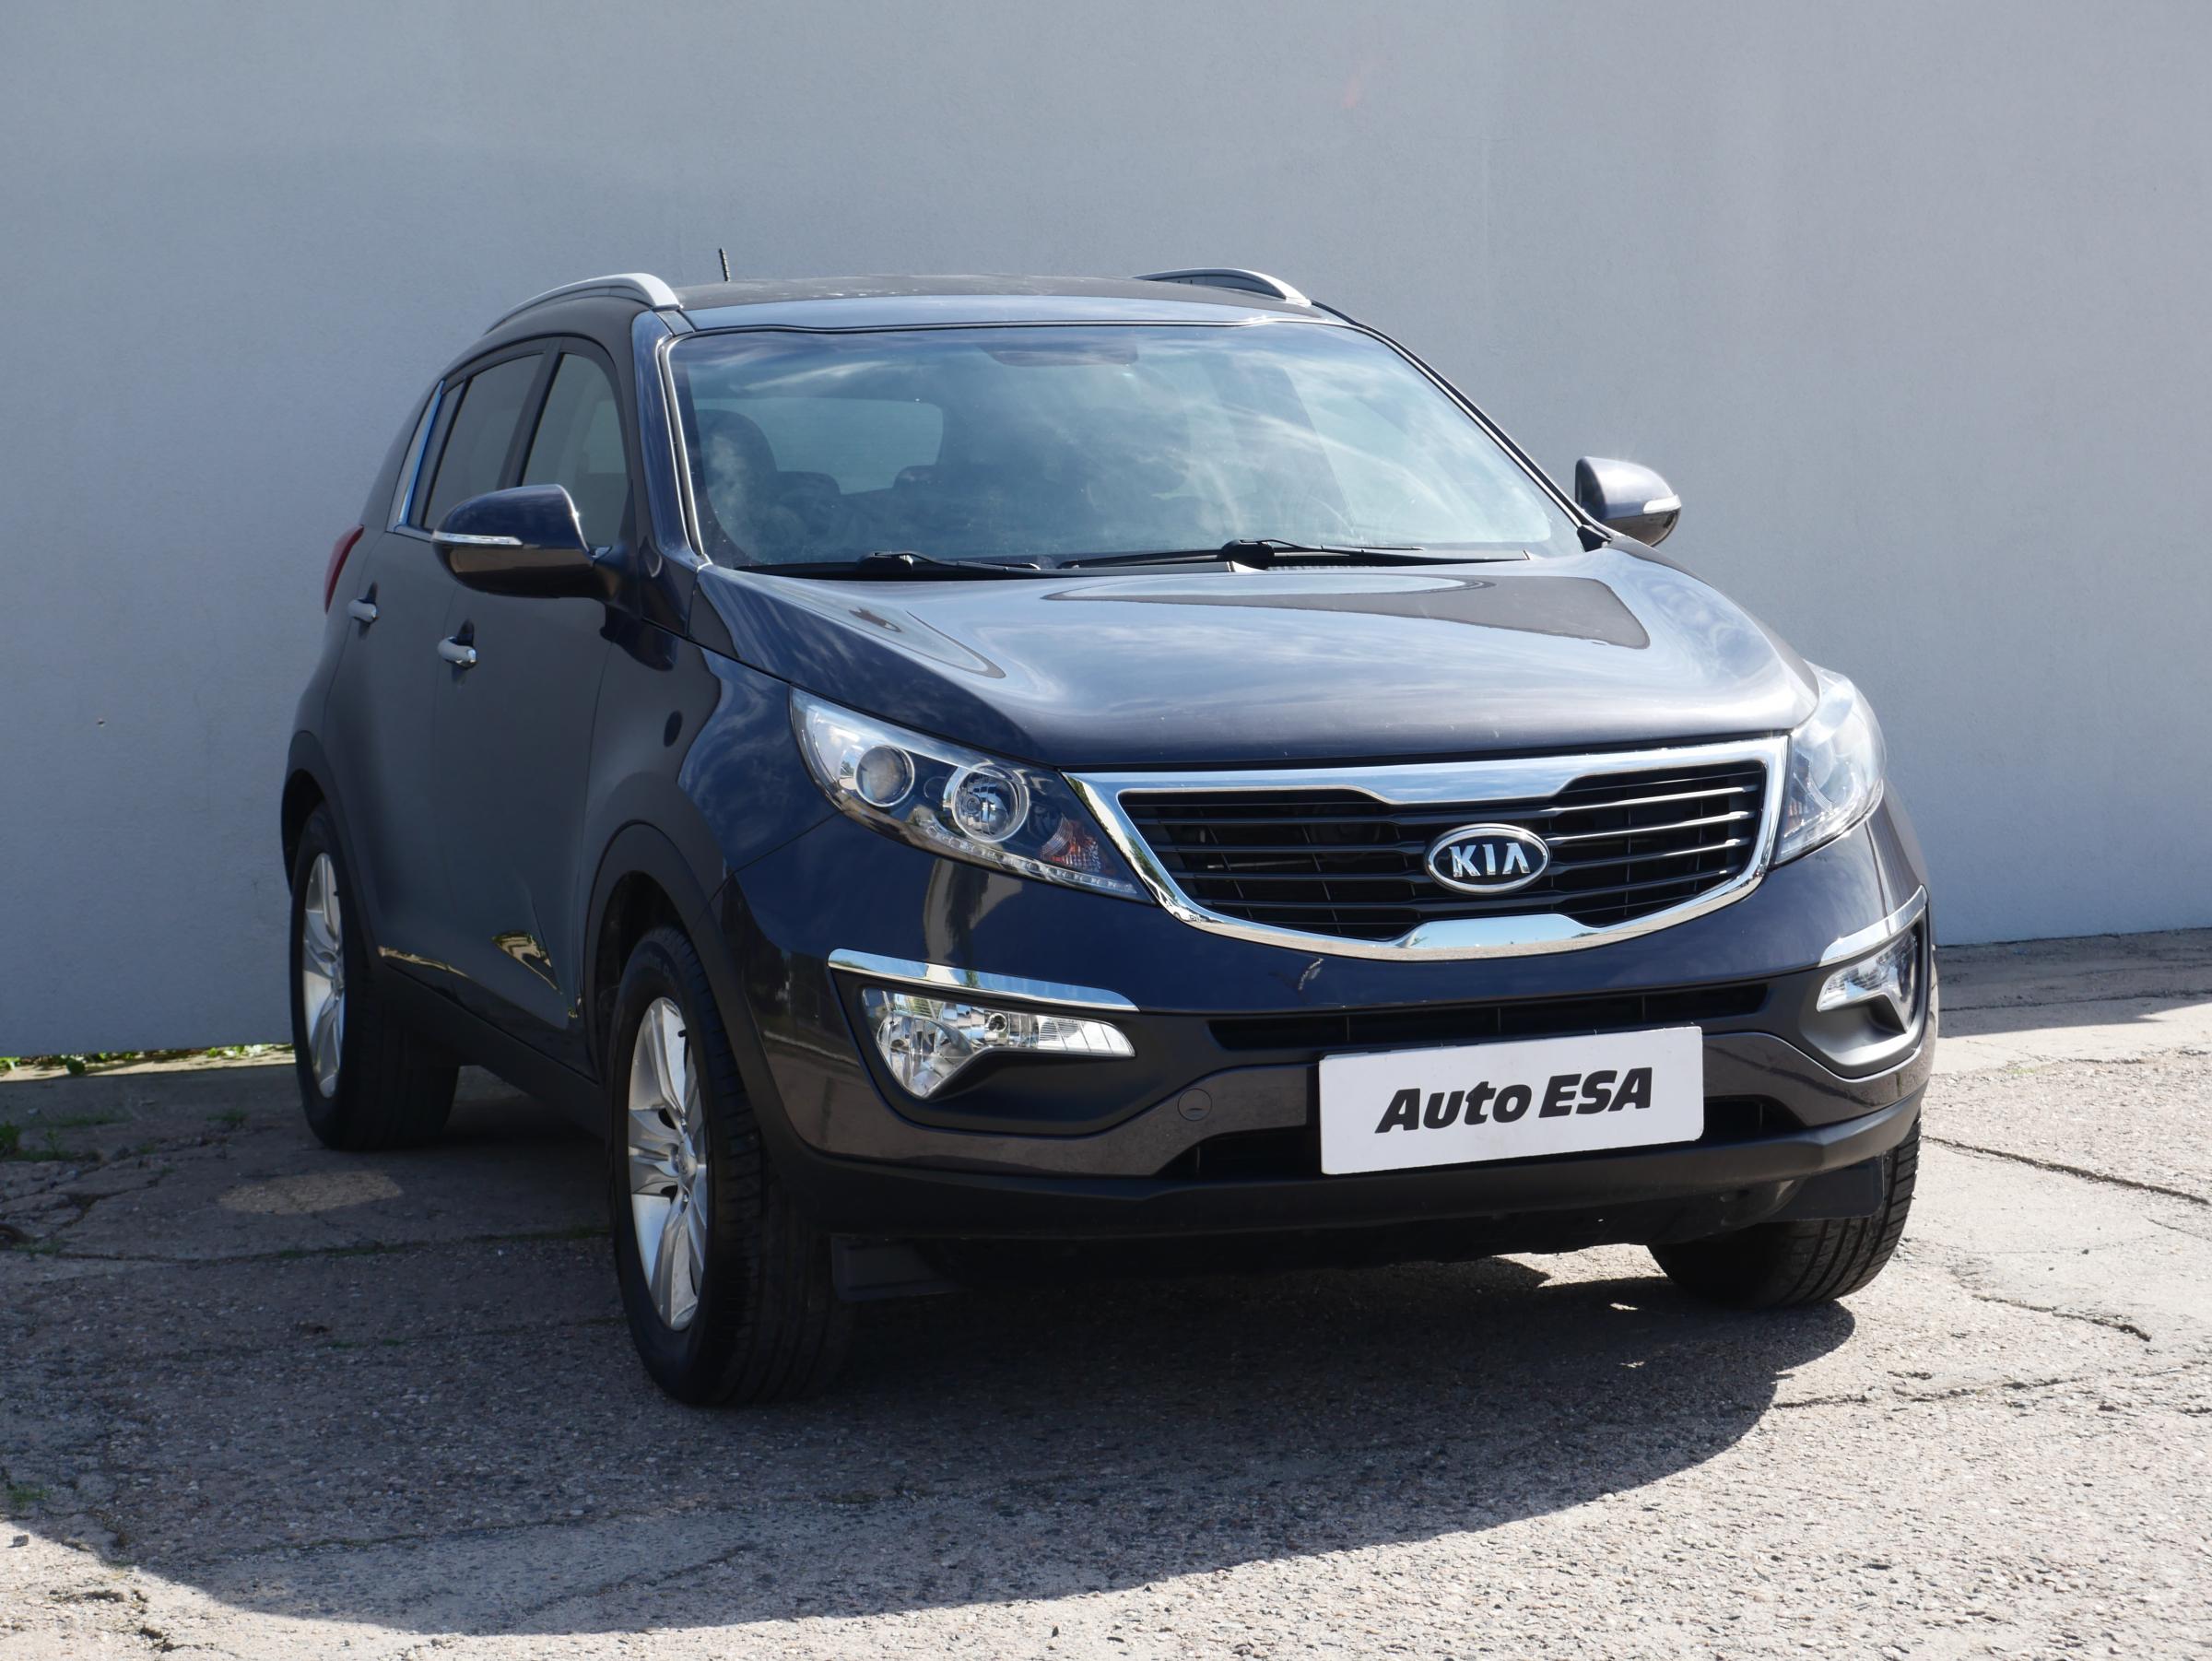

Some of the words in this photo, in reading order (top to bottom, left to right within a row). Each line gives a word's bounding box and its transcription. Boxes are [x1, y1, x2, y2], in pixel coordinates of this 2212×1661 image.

[1449, 842, 1531, 878] KIA
[1374, 1080, 1533, 1134] Auto
[1538, 1066, 1653, 1119] ESA
